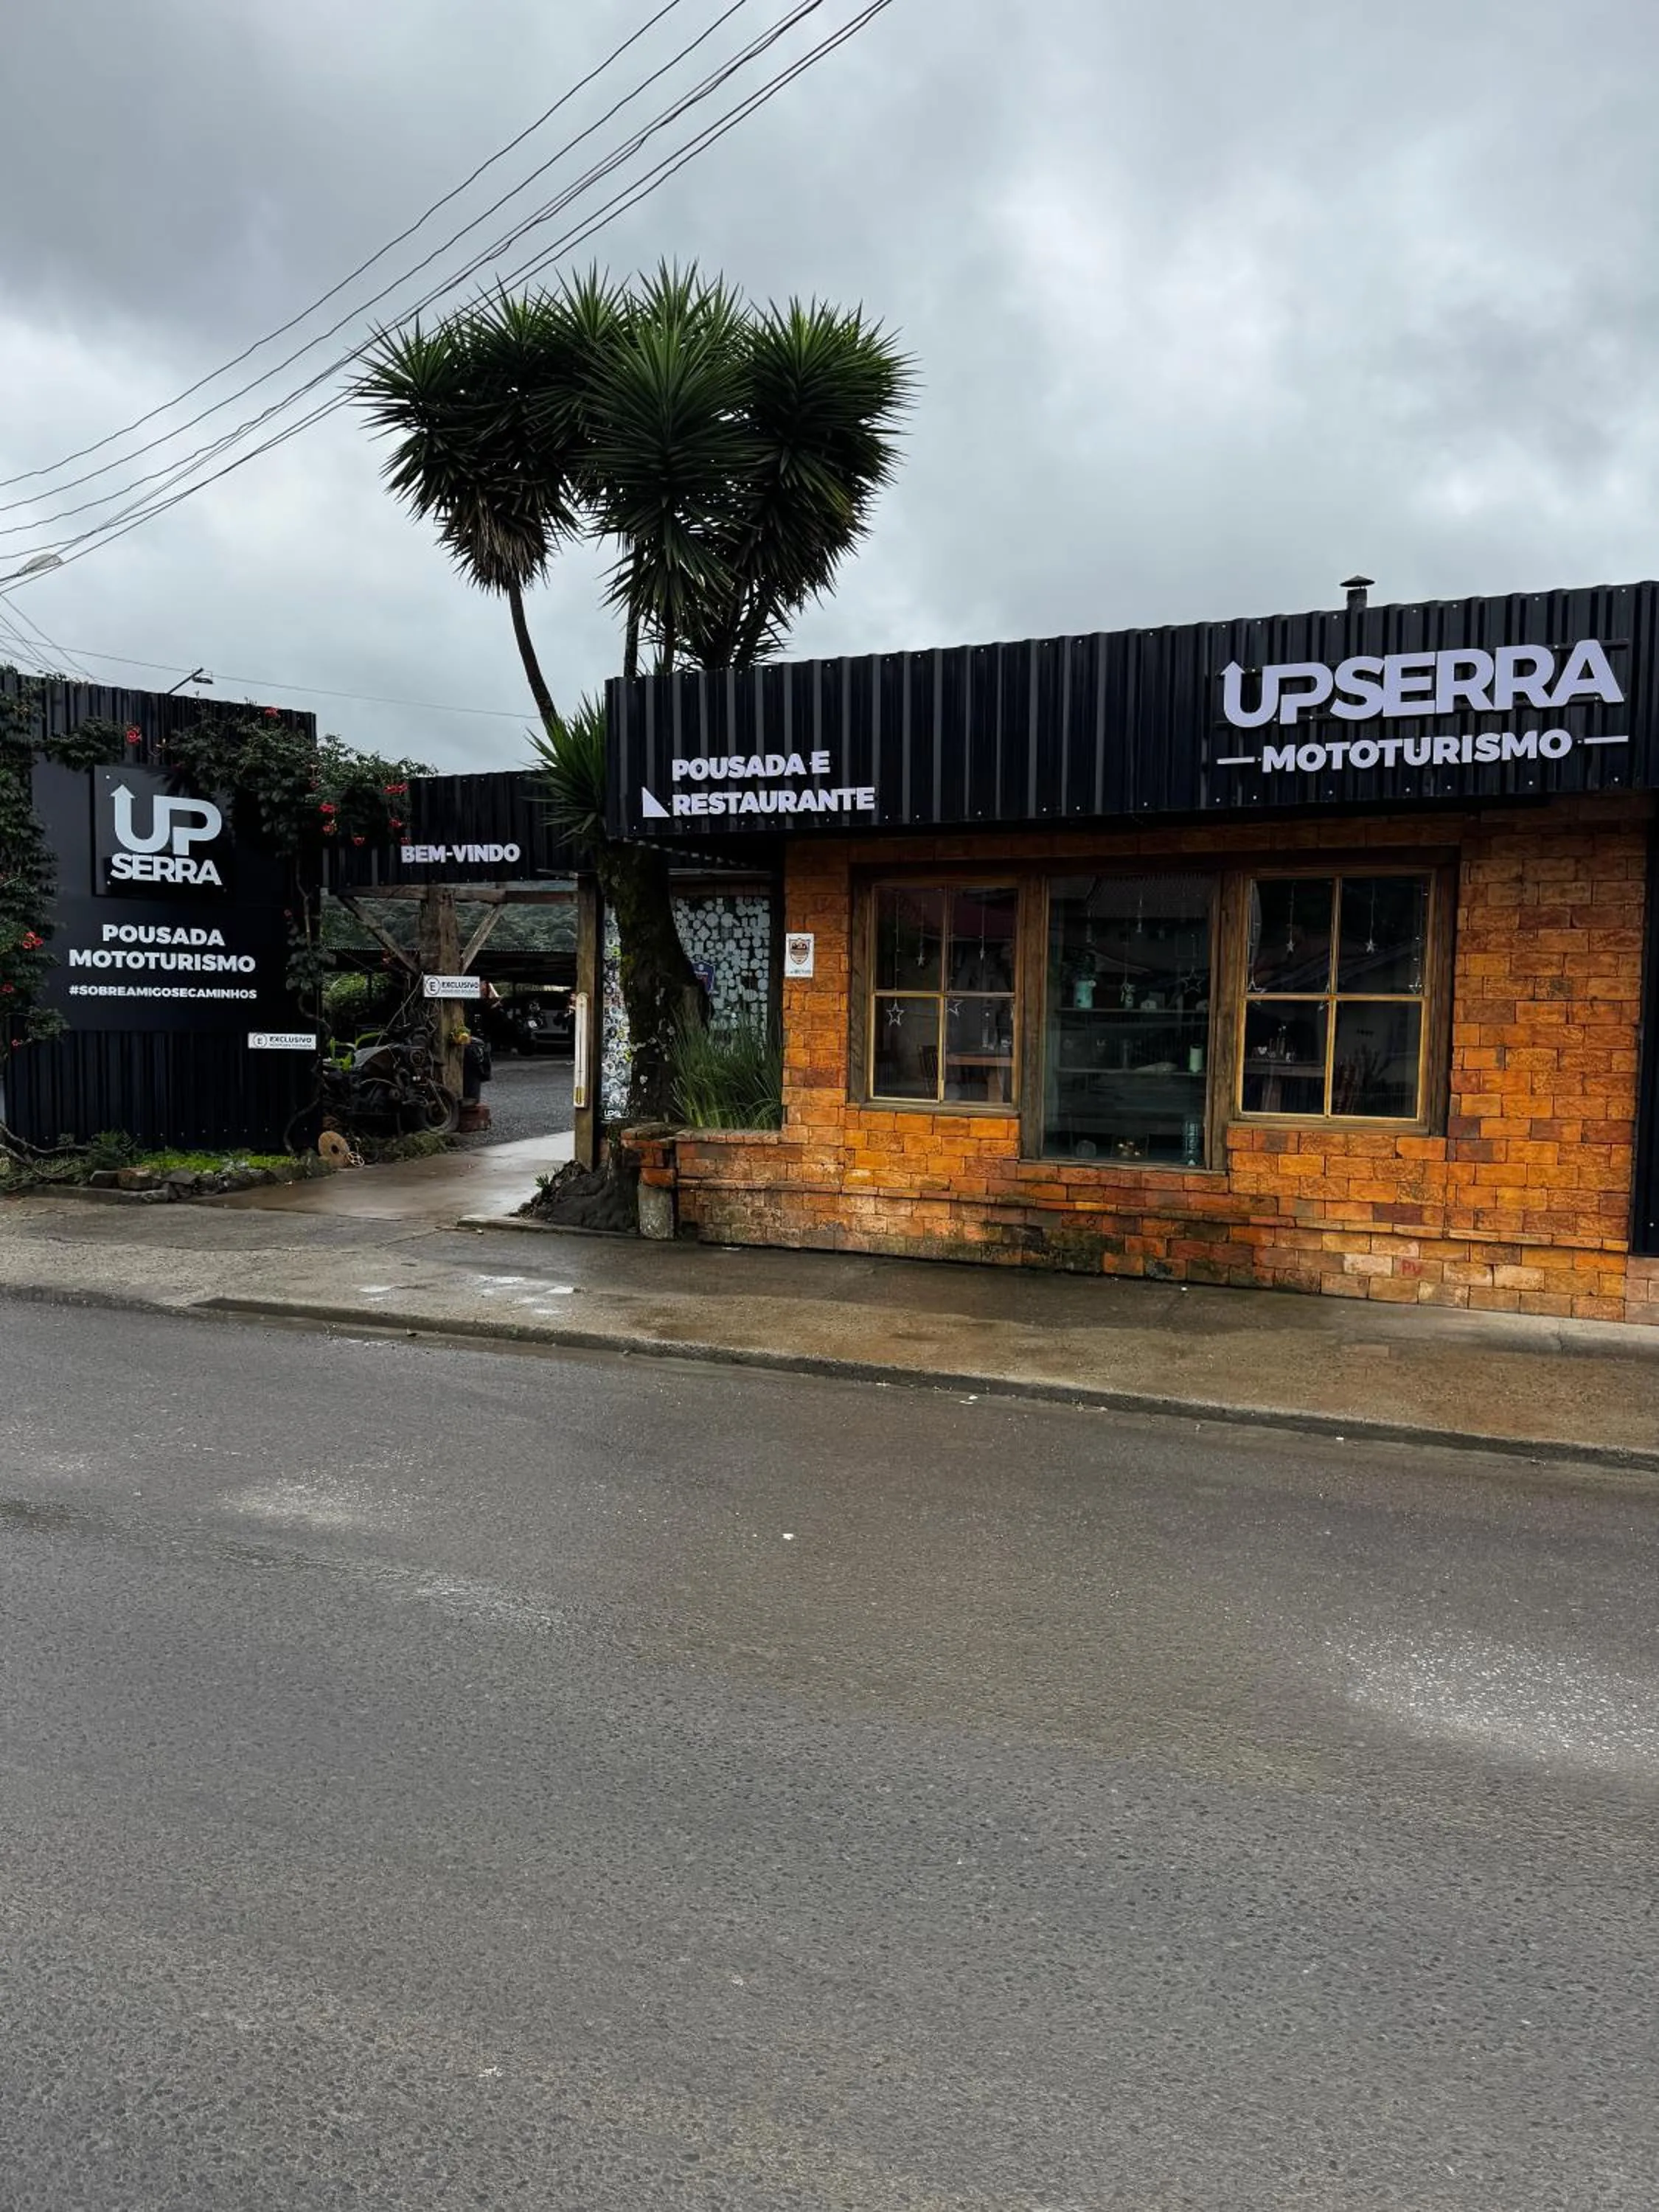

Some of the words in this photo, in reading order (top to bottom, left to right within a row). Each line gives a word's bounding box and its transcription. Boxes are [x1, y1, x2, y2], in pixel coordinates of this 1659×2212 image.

[1262, 729, 1572, 773] MOTOTURISMO
[672, 754, 807, 781] POUSADA
[811, 751, 830, 773] E
[672, 787, 875, 816] RESTAURANTE
[110, 784, 222, 855] UP
[400, 844, 521, 863] BEM-VINDO
[111, 852, 223, 885] SERRA
[102, 925, 225, 946] POUSADA
[69, 950, 256, 973] MOTOTURISMO
[69, 985, 257, 999] #SOBREAMIGOSECAMINHOS
